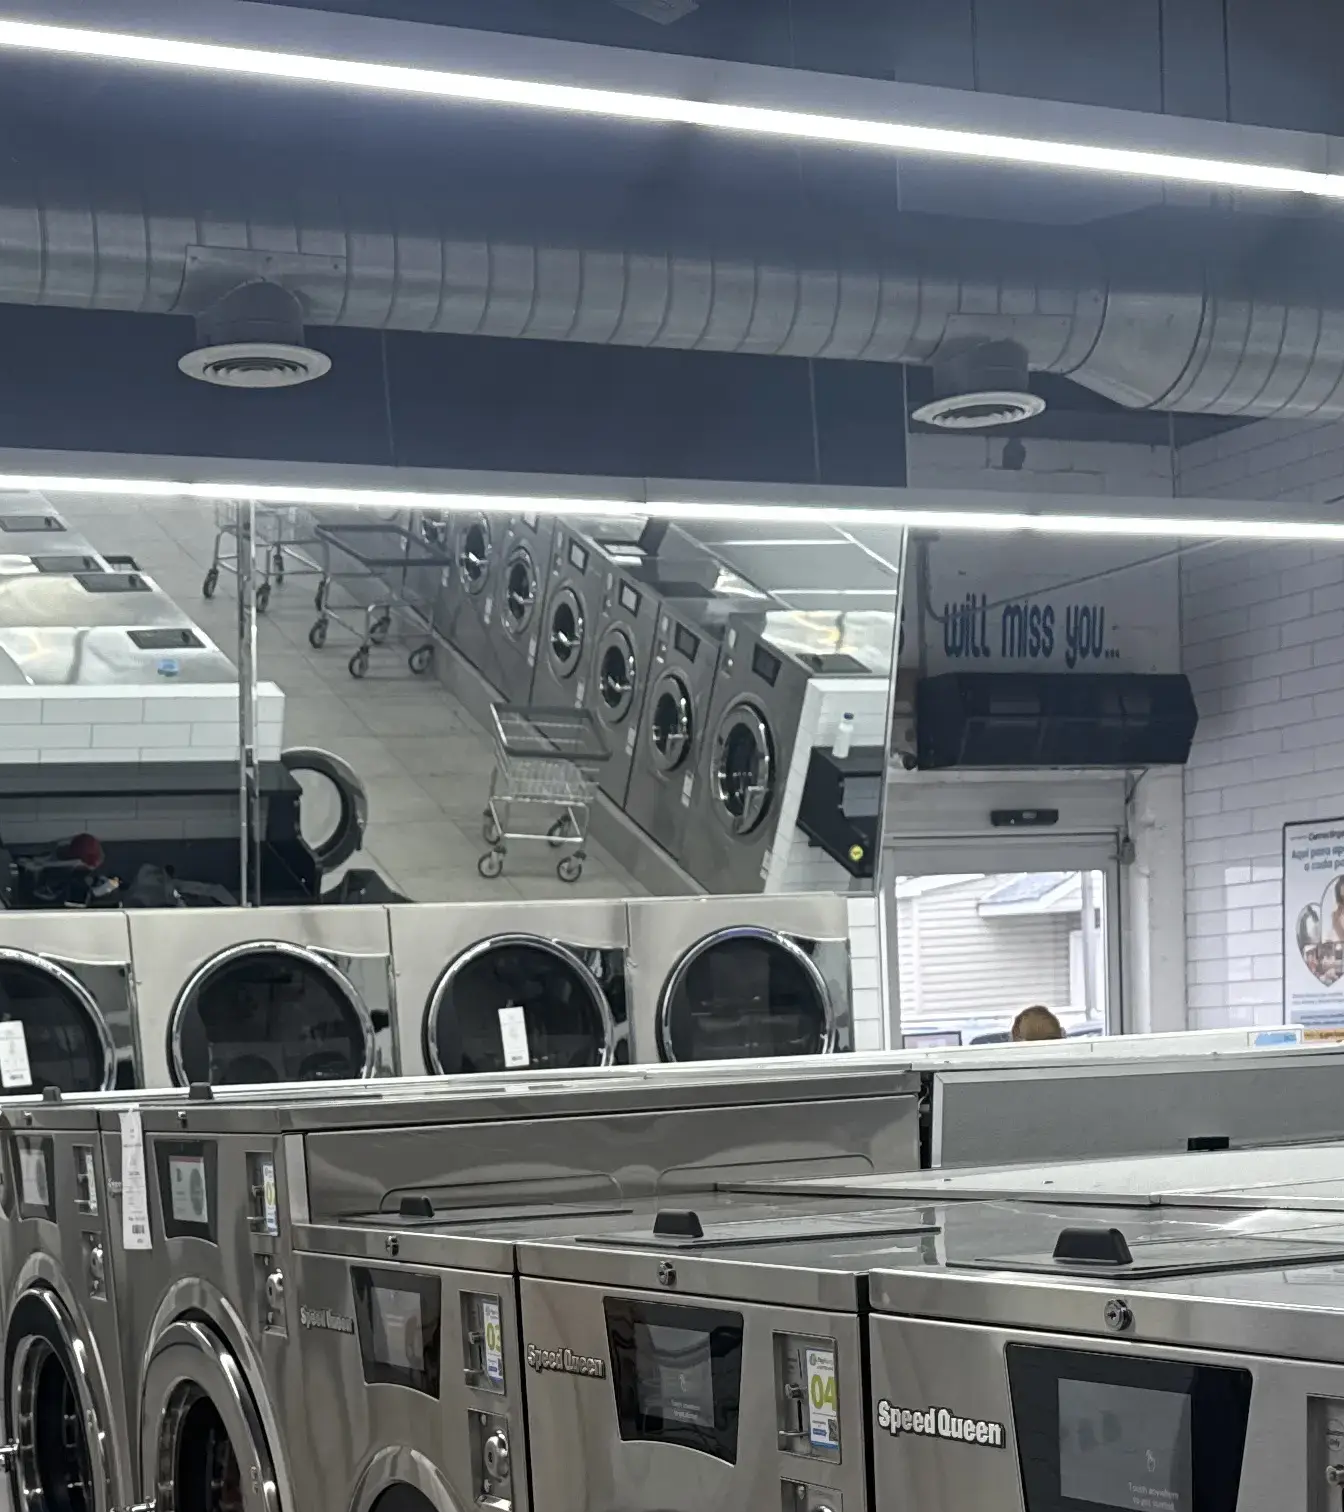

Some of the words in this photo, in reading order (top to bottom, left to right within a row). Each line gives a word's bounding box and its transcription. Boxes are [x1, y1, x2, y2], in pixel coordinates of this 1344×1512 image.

[943, 593, 991, 658] will
[1002, 601, 1055, 658] miss
[528, 1344, 563, 1373] Speed
[563, 1348, 605, 1378] Queen
[810, 1374, 837, 1412] 04
